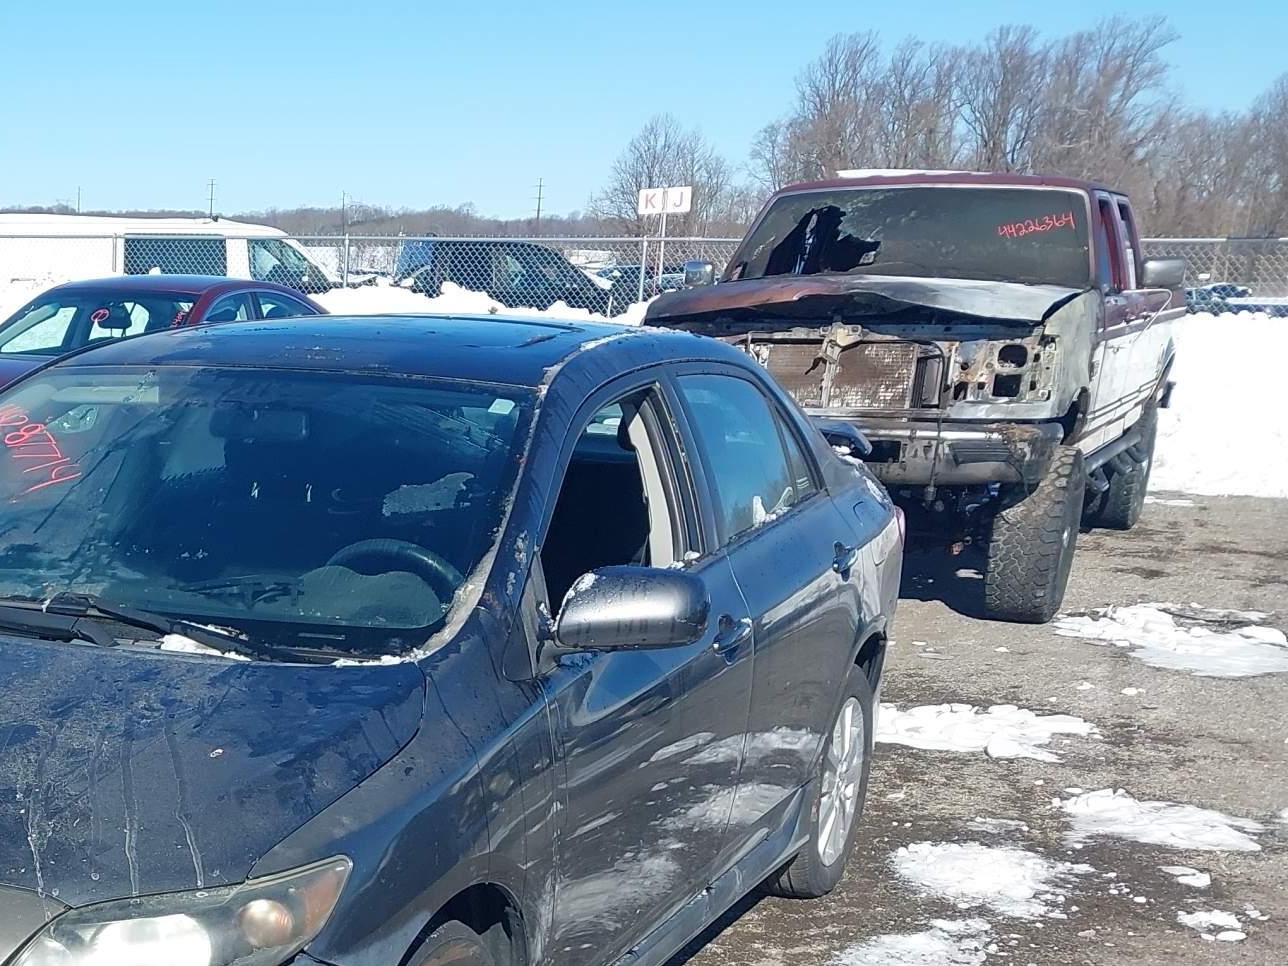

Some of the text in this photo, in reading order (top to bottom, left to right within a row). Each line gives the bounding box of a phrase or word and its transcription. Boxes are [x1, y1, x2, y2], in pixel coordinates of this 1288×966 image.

[644, 193, 657, 209] K
[673, 191, 684, 208] J
[998, 211, 1075, 239] 44226364
